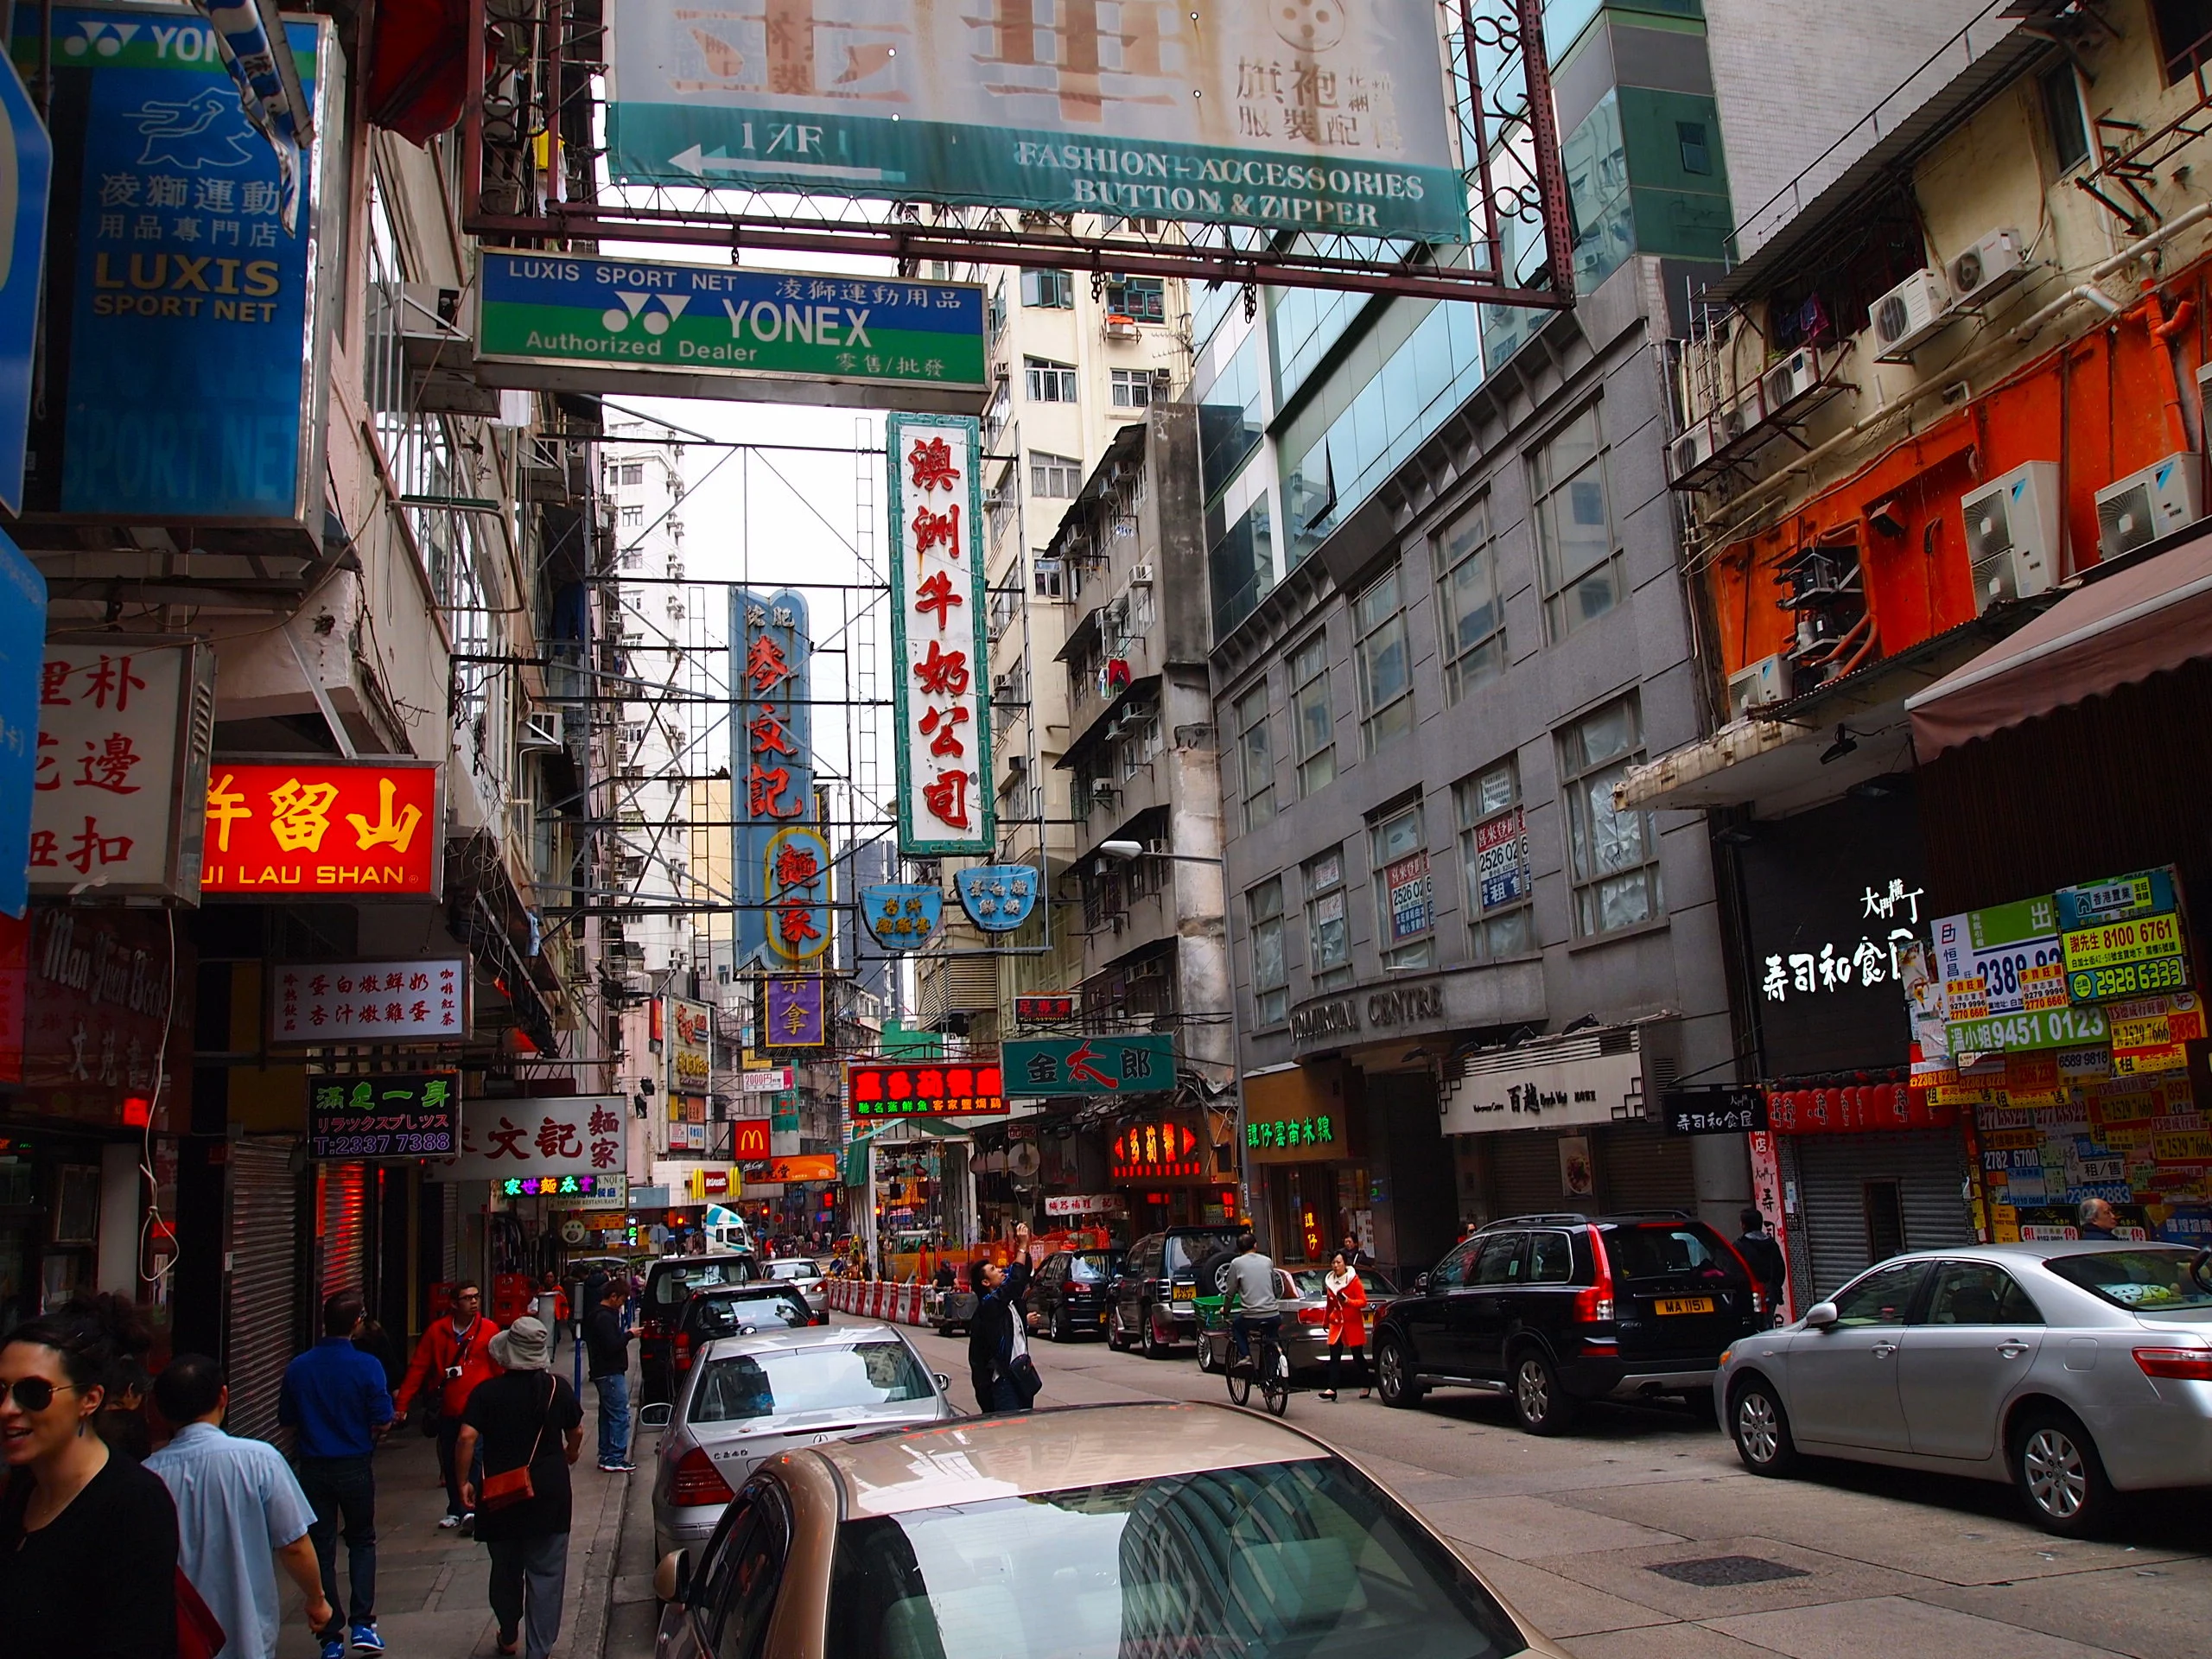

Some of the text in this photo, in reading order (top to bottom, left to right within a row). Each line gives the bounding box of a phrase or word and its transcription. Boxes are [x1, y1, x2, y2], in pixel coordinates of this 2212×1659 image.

[1073, 179, 1222, 215] BUTTON
[1258, 195, 1378, 226] ZIPPER
[95, 213, 278, 249] 用品專門店
[94, 252, 279, 297] LUXIS
[509, 259, 736, 292] LUXIS SPORT NET
[93, 296, 277, 323] SPORT NET
[774, 277, 963, 311] 凌獅運動用品
[721, 297, 872, 347] YONEX
[526, 330, 758, 362] Authorized Dealer
[908, 436, 969, 830] 澳洲牛奶公司
[1480, 847, 1503, 872] 2526
[239, 866, 301, 884] LAU
[316, 866, 404, 885] SHAN
[1394, 884, 1412, 906] 2526
[2031, 902, 2052, 931] 出
[2103, 925, 2134, 949] 8100
[2139, 918, 2172, 943] 6761
[2095, 966, 2136, 996] 2928
[2138, 958, 2183, 989] 6333
[440, 969, 454, 1027] 咖啡紅茶
[1368, 986, 1444, 1024] CENTRE
[2024, 991, 2043, 1000] 9279
[2024, 996, 2067, 1010] 2770 6661
[1950, 1011, 1967, 1021] 2770
[1992, 1015, 2041, 1049] 9451
[2049, 1007, 2103, 1041] 0123
[1026, 1039, 1151, 1090] 金太郎
[2058, 1051, 2107, 1068] 6589 9818
[316, 1080, 450, 1109] 滿足一身
[1918, 1072, 1937, 1086] 2362
[314, 1132, 450, 1155] T:2337 7388
[588, 1104, 620, 1168] 麵家
[1247, 1116, 1332, 1148] 譚仔雲南米線
[1984, 1148, 2038, 1170] 2782 6700
[1664, 1300, 1705, 1313] MA 1151
